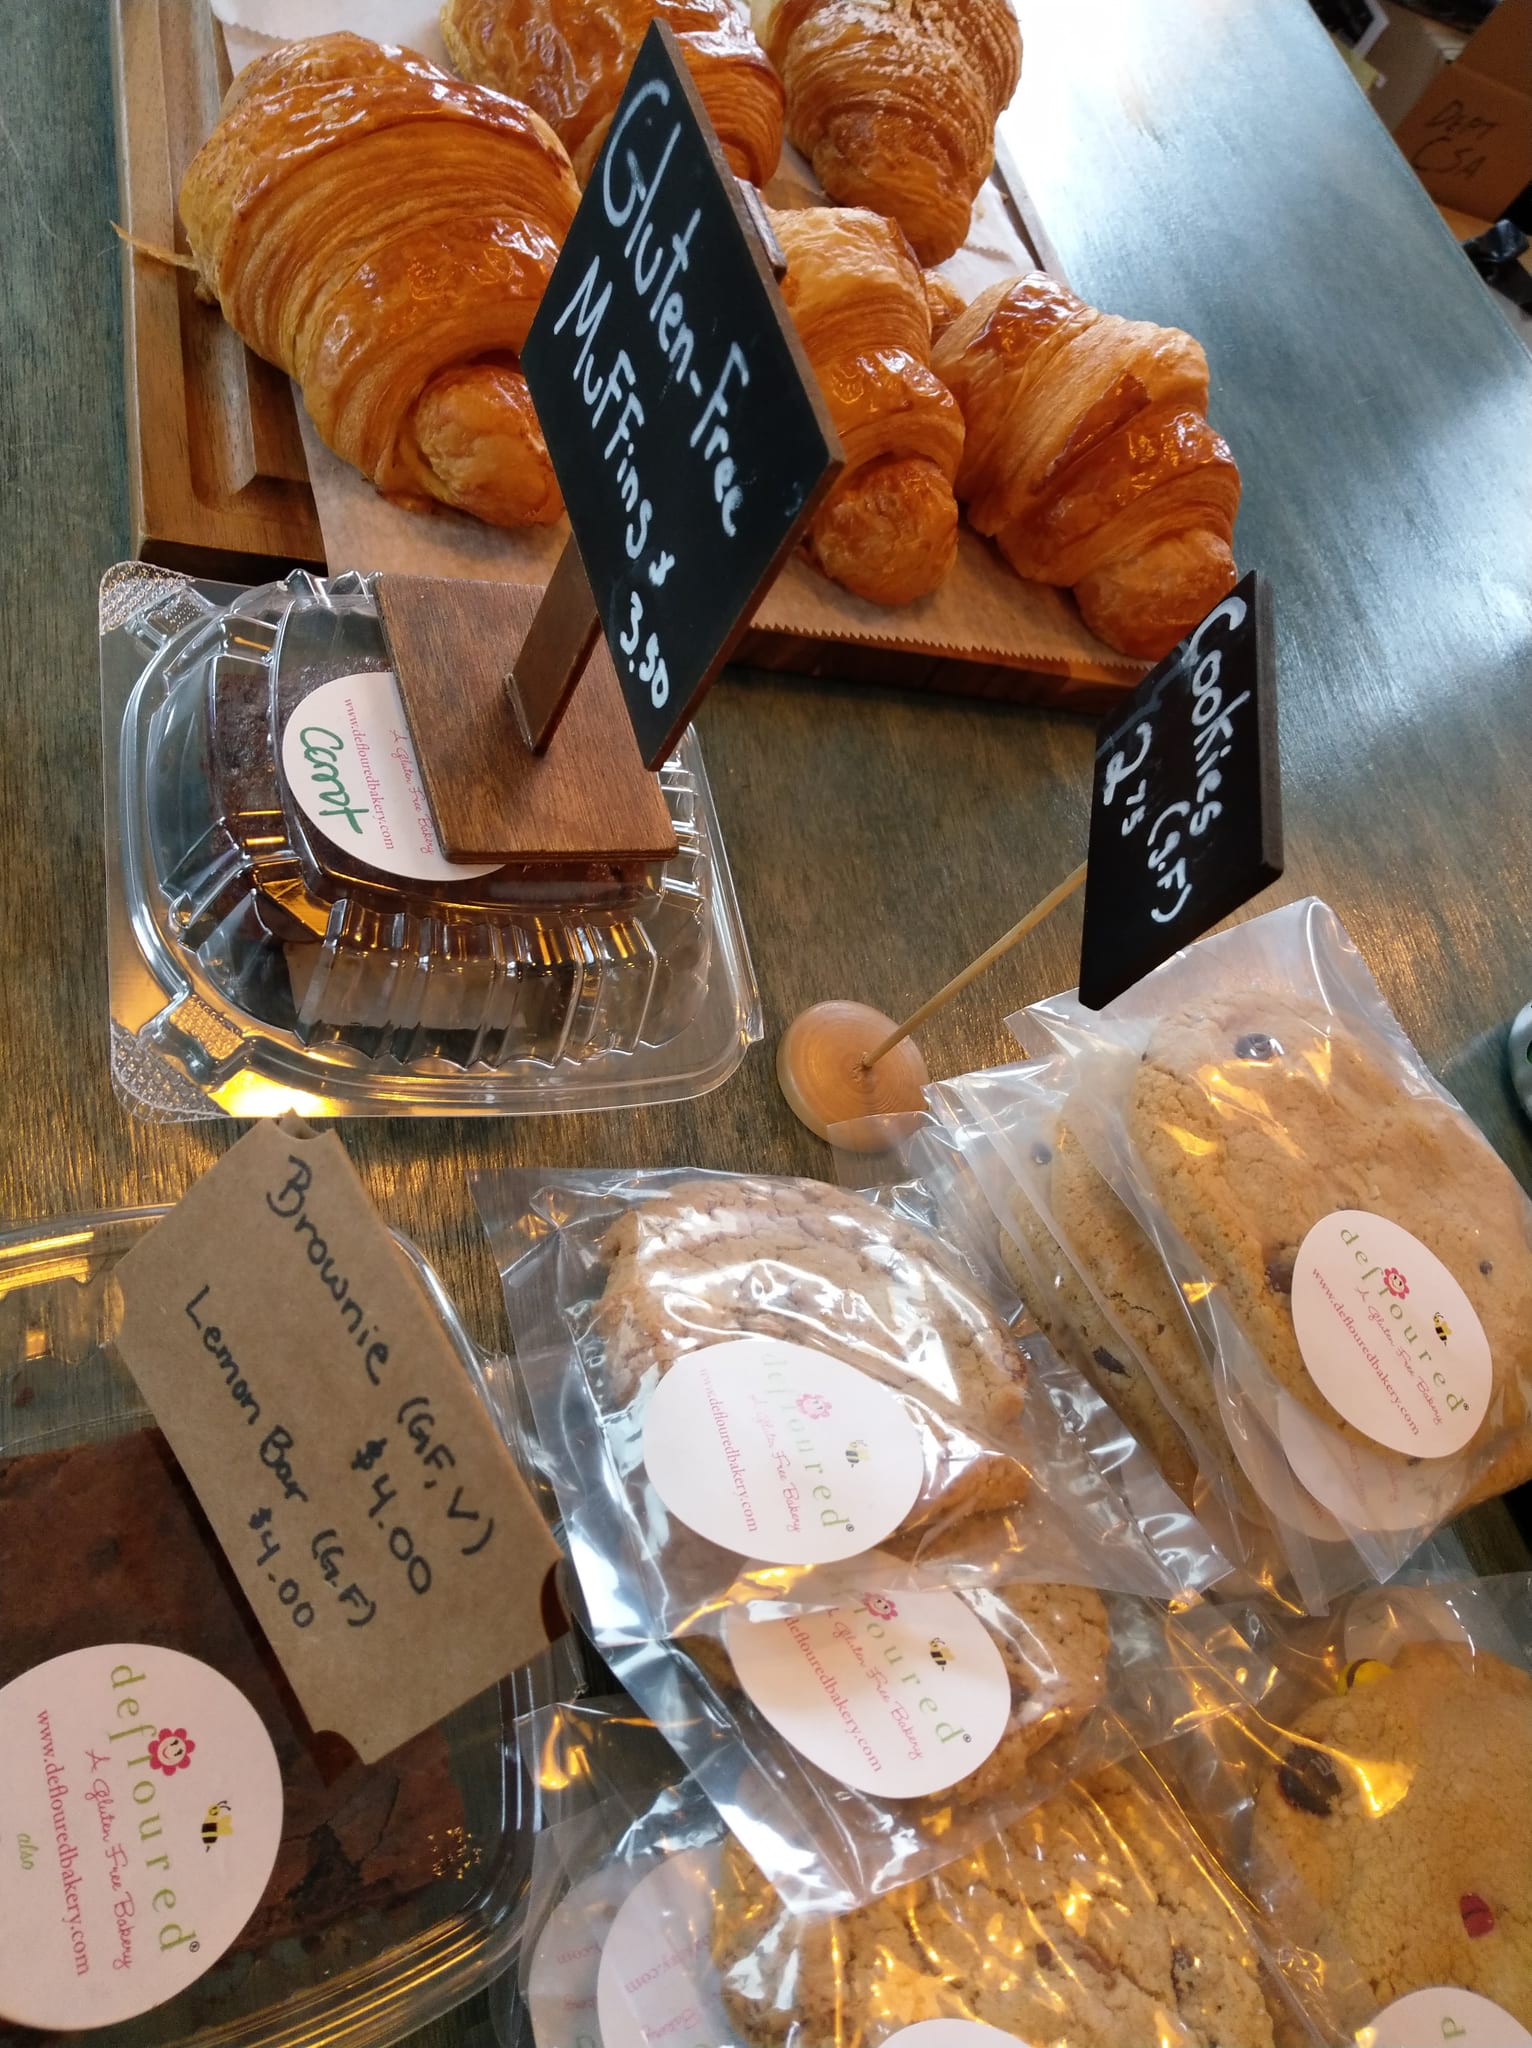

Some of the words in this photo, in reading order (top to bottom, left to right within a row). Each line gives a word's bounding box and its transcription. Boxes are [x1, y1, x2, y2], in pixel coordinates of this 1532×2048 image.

[603, 79, 749, 537] Gluten-Free
[343, 698, 395, 850] www.deflouredbakery.com
[1180, 595, 1250, 837] Cookies
[265, 1154, 391, 1387] Brownie
[184, 1284, 262, 1428] Lemon
[258, 1423, 309, 1505] Bar
[1311, 1267, 1421, 1437] www.deflouredbakery.com
[247, 1505, 316, 1630] $4.00
[350, 1436, 433, 1596] $4.00
[782, 1481, 802, 1534] Bakery
[16, 1832, 39, 1872] also
[36, 1709, 90, 1977] www.deflouredbakery.com
[83, 1777, 115, 1844] Gluten
[104, 1843, 130, 1892] Free
[111, 1889, 137, 1972] Bakery
